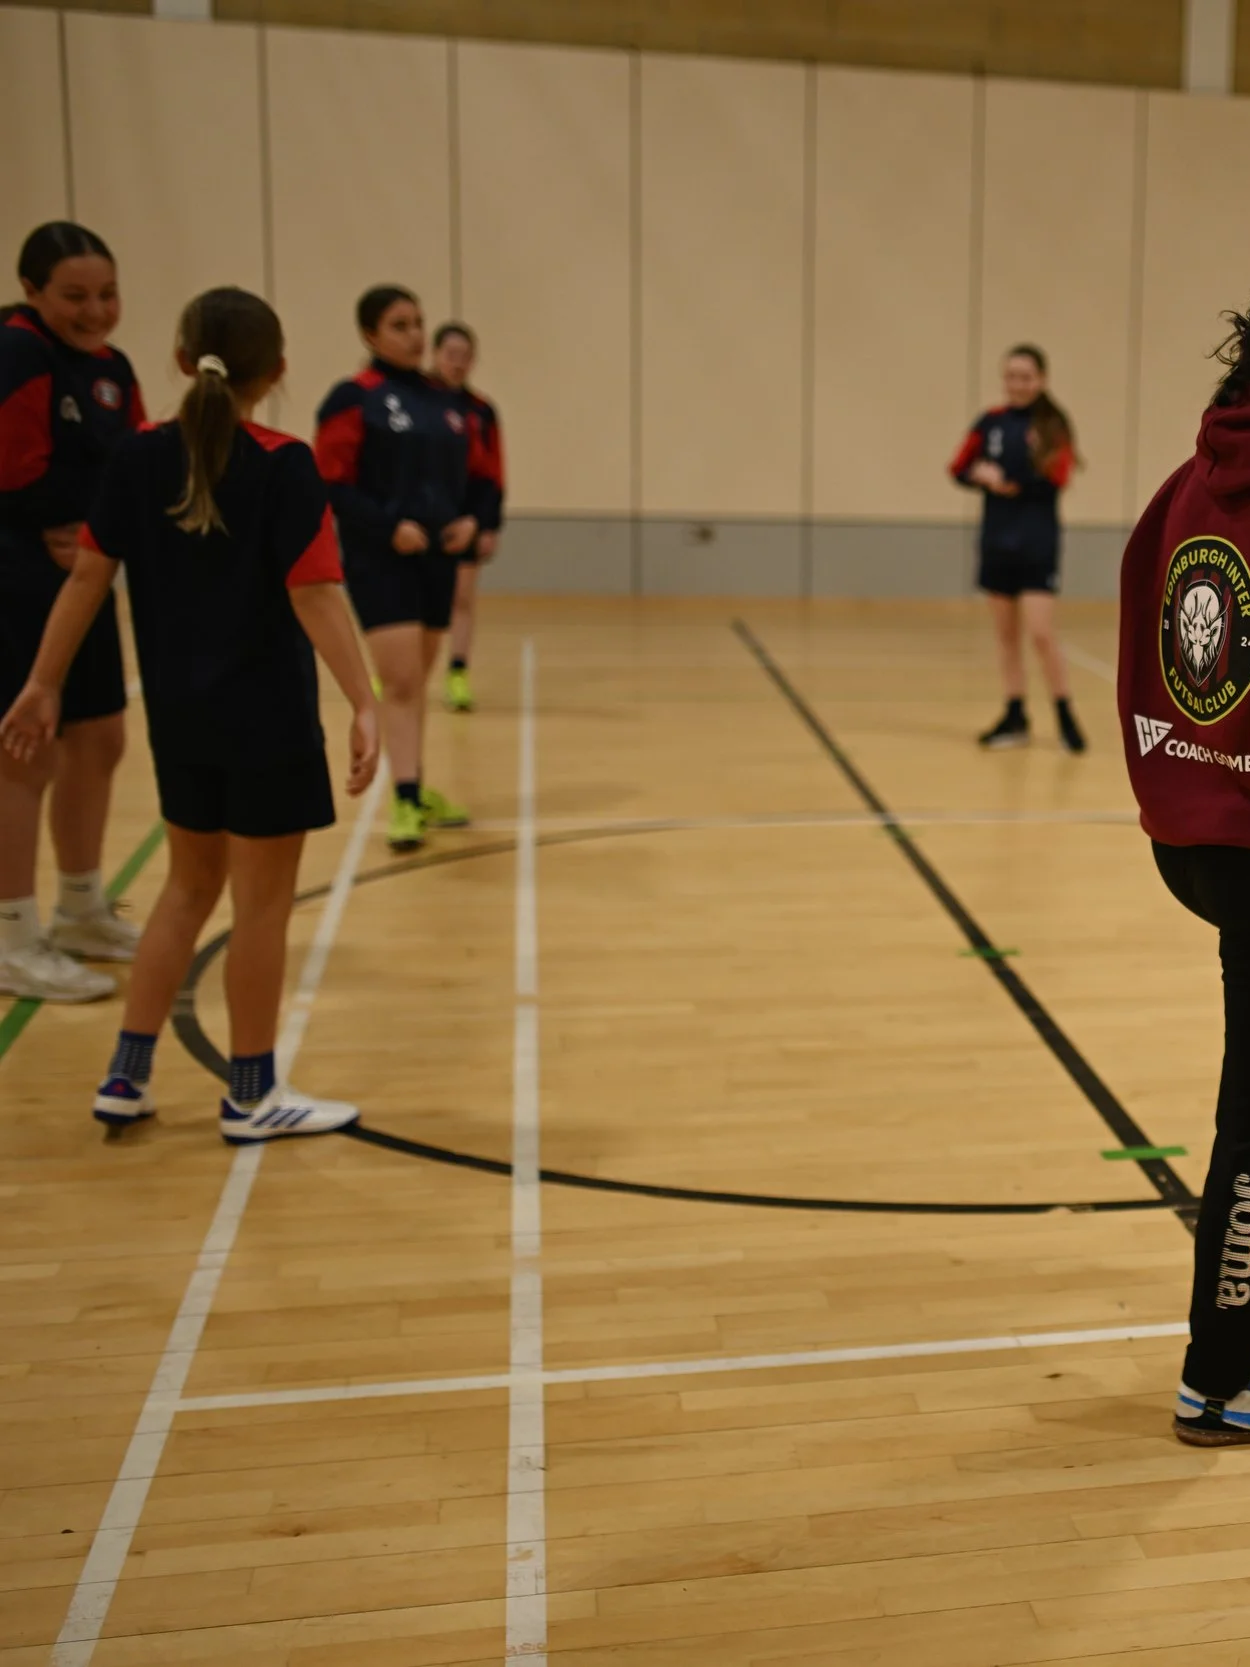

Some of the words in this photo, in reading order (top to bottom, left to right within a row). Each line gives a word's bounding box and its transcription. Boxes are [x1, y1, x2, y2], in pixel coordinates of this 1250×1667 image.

[1165, 548, 1229, 606] EDINBURGH
[1168, 666, 1205, 714] FUTSAL
[1205, 680, 1237, 714] CLUB
[1164, 739, 1213, 764] COACH
